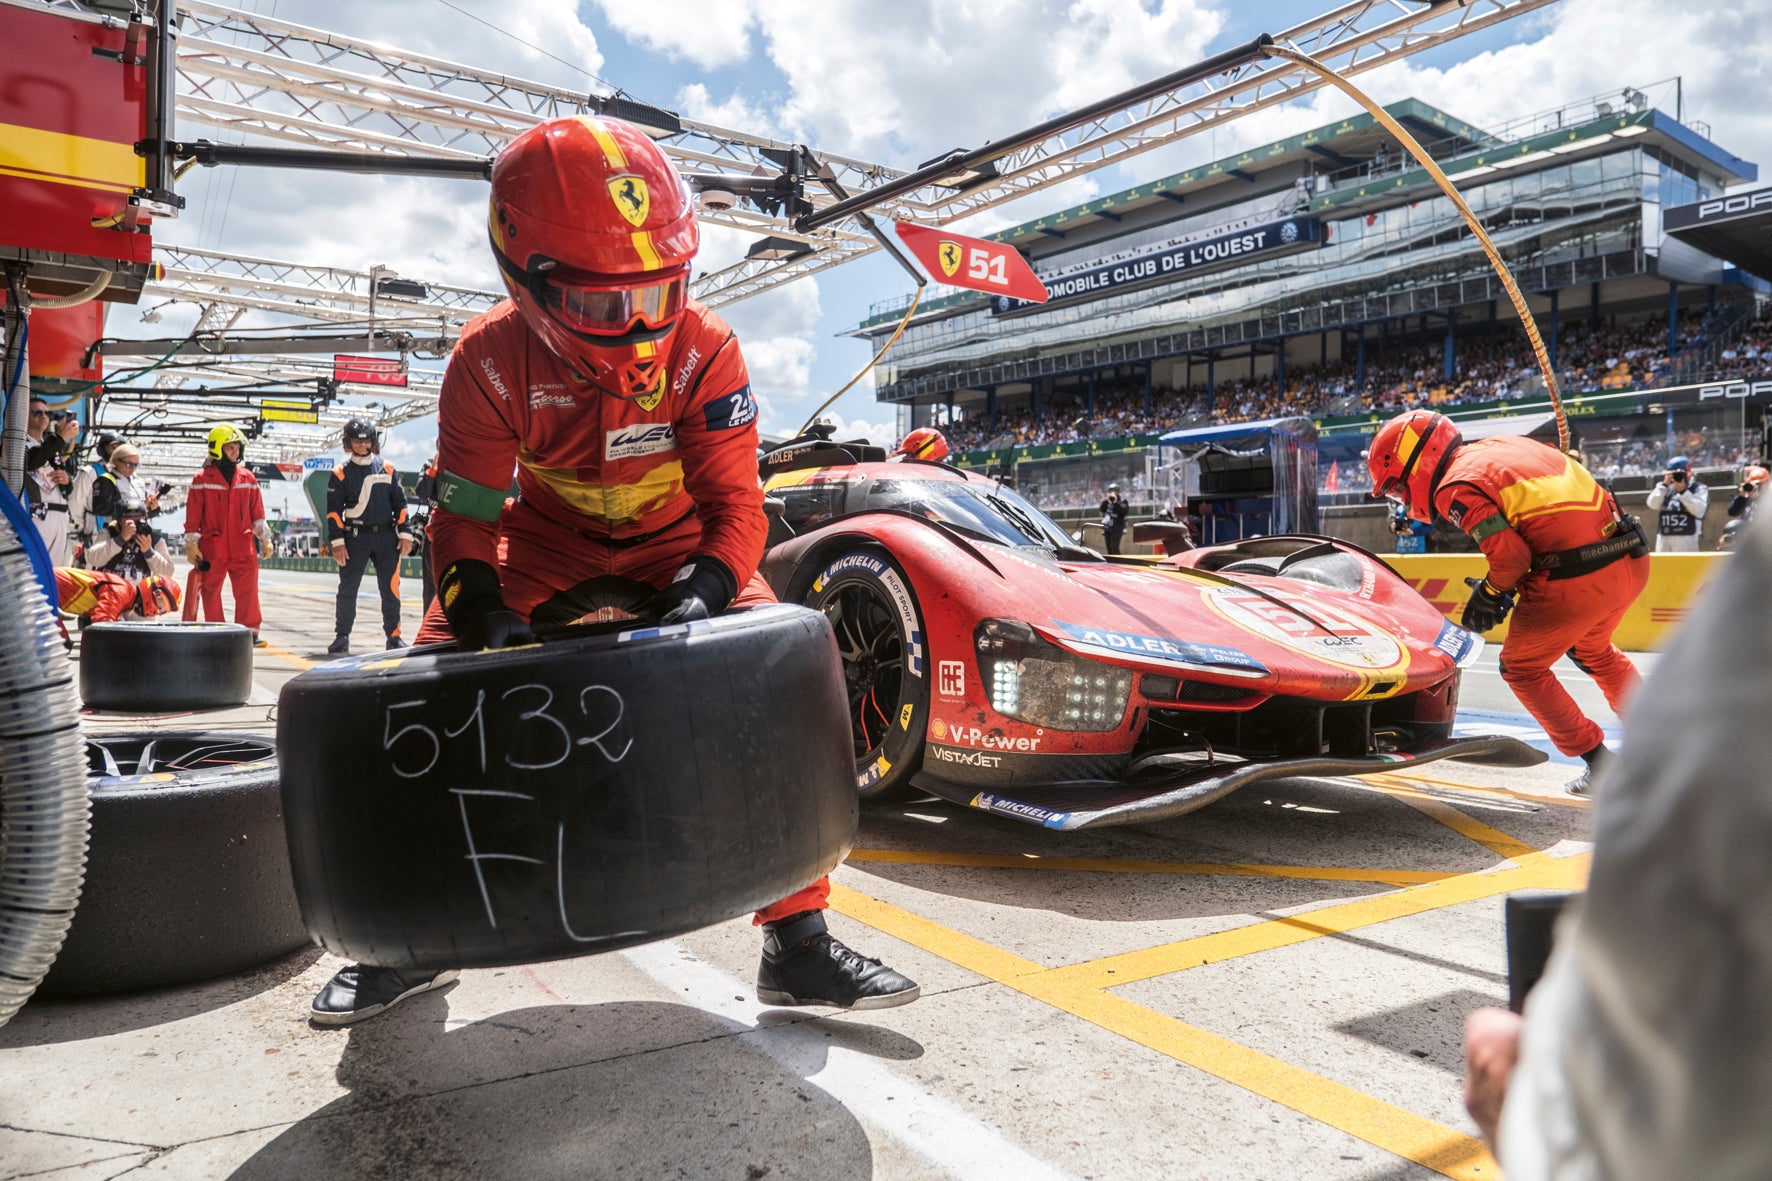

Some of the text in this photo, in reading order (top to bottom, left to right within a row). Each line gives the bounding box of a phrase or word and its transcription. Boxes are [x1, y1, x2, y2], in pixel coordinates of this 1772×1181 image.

[968, 248, 1009, 286] 51
[1113, 260, 1157, 283] CLUB
[1162, 253, 1185, 272] DE
[1190, 231, 1266, 265] L'OUEST
[673, 345, 702, 395] Sabelt
[768, 450, 793, 465] ADLER
[830, 555, 883, 576] MICHELIN
[886, 575, 913, 623] PILOT SPORT
[1080, 631, 1184, 657] ADLER
[1214, 654, 1251, 666] GROUP
[384, 684, 634, 778] 5132
[995, 799, 1066, 823] MICHELIN
[448, 788, 648, 942] FL
